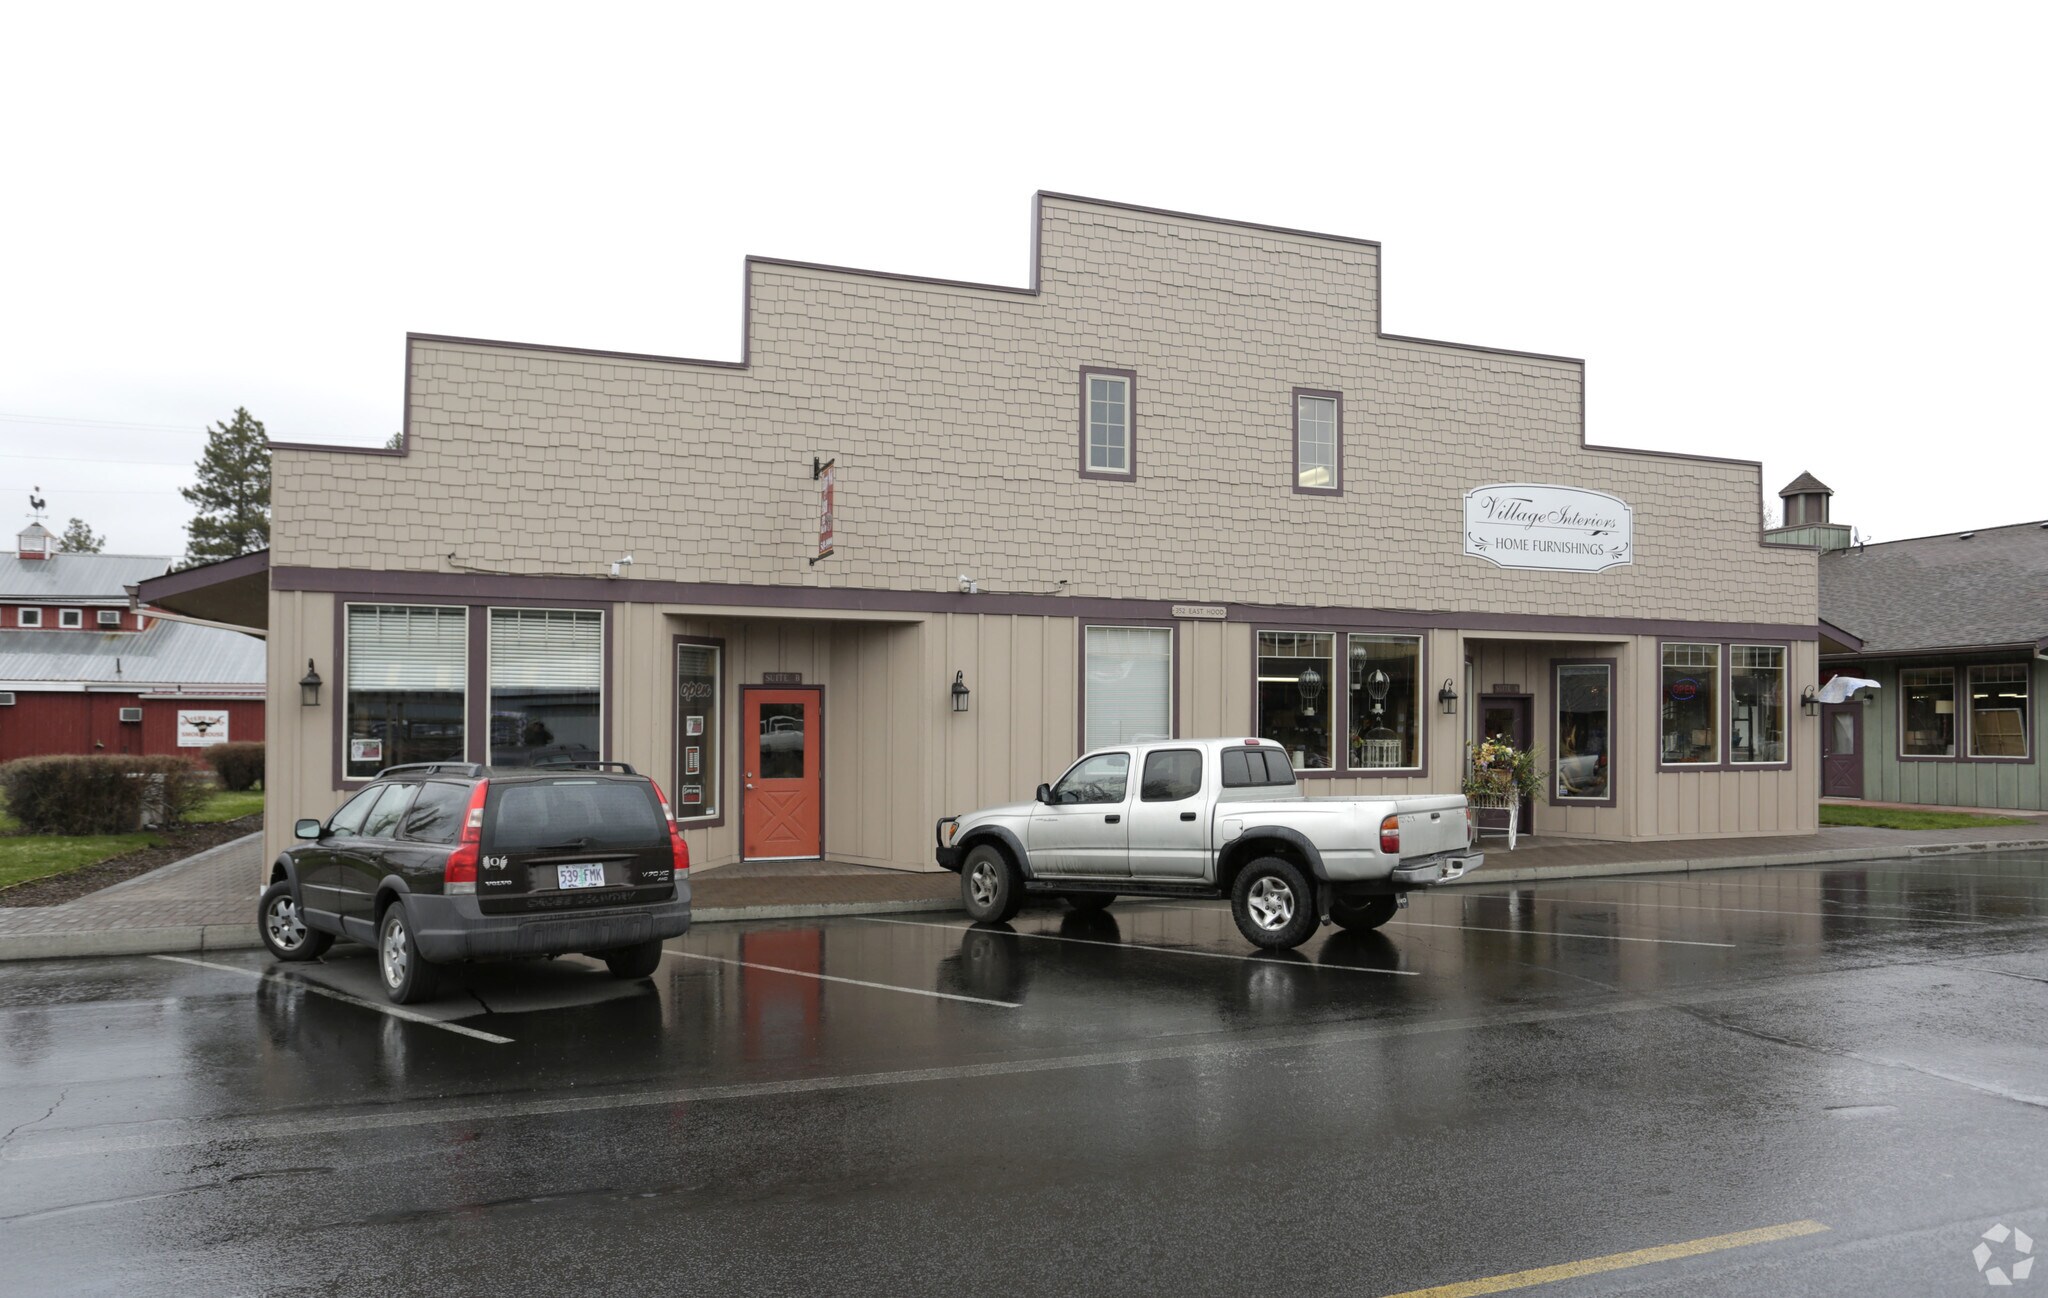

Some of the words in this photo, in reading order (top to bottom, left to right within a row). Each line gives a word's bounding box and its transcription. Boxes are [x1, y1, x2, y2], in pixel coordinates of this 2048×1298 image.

[1481, 496, 1546, 530] Village
[1547, 505, 1616, 528] Interiors
[1495, 537, 1529, 551] HOME
[1533, 540, 1604, 556] FURNISHINGS
[765, 674, 788, 682] SUITE
[680, 681, 712, 701] open
[1672, 684, 1697, 694] OPEN
[560, 870, 578, 884] 539
[584, 868, 603, 881] FMK
